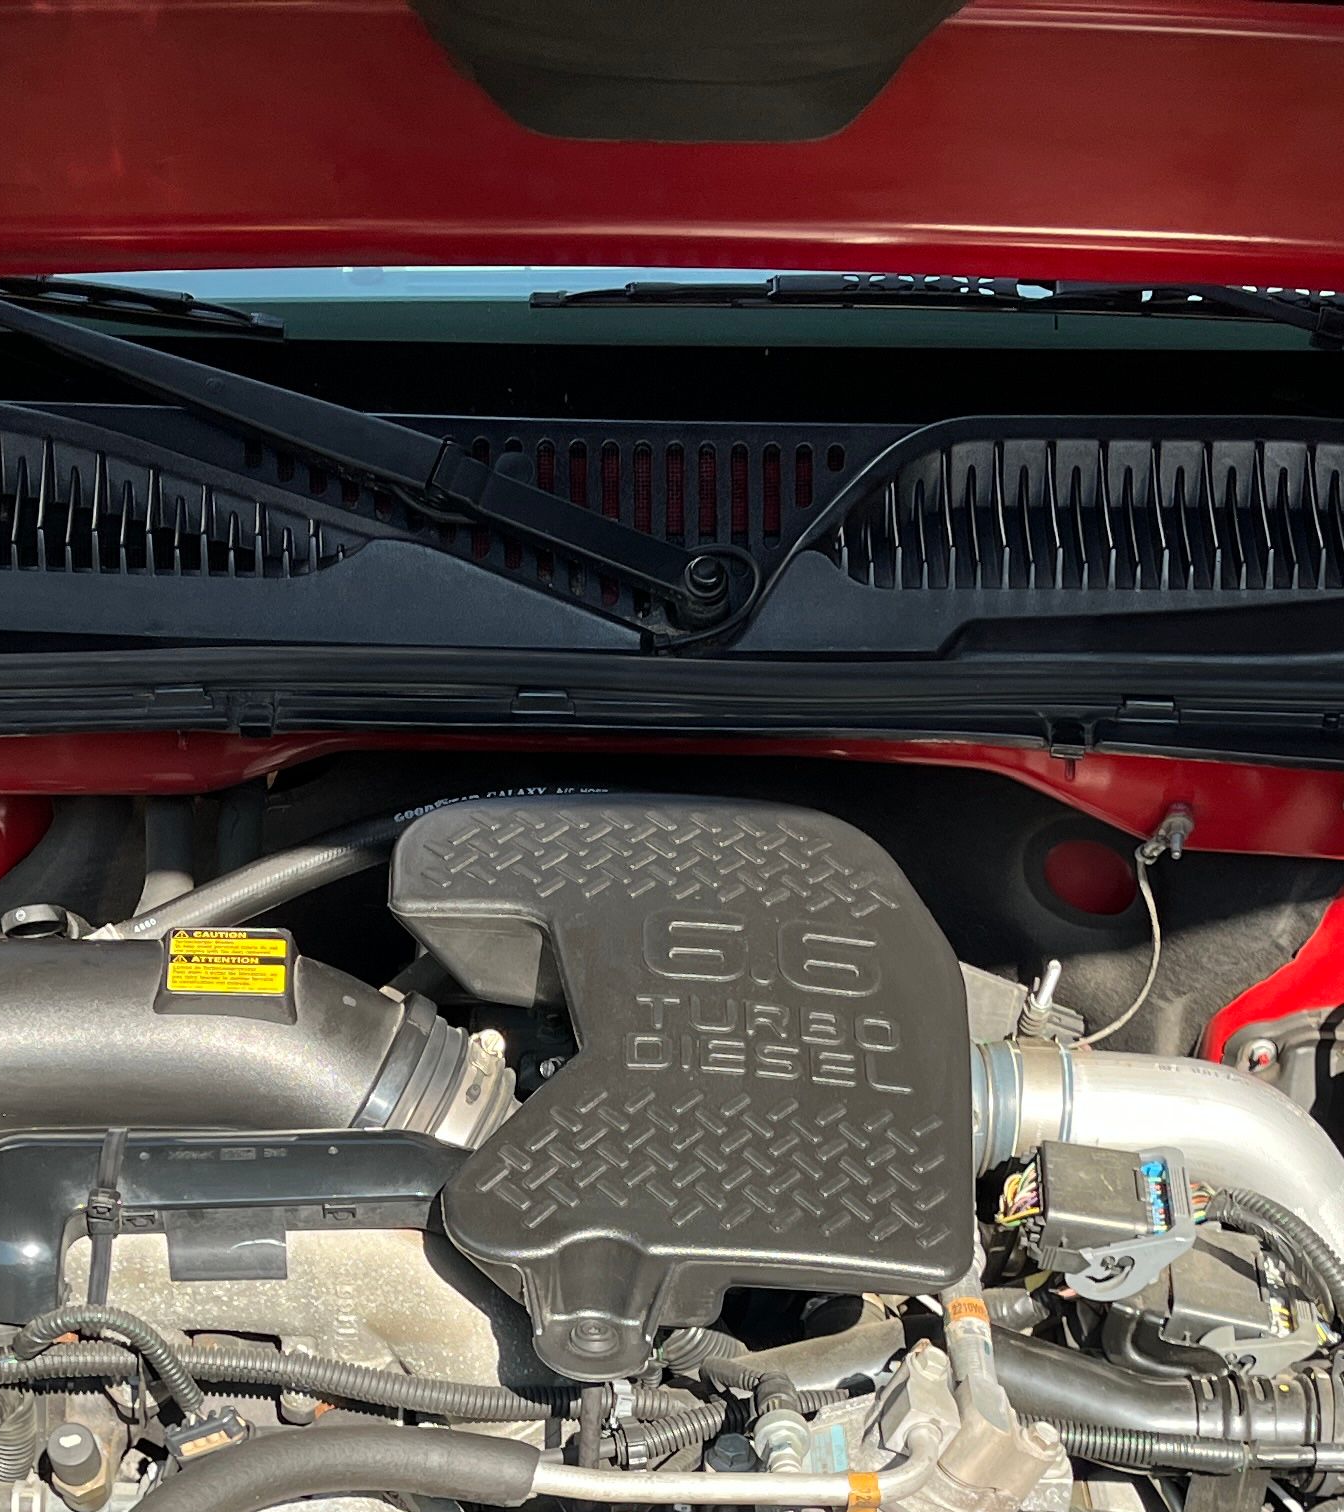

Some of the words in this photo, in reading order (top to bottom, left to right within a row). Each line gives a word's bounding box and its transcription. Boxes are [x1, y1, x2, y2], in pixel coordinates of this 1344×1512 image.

[191, 956, 260, 964] ATTENTION
[192, 930, 247, 939] CAUTION
[642, 908, 882, 998] 6.6
[636, 993, 901, 1053] TURBO
[625, 1032, 913, 1094] DIESEL
